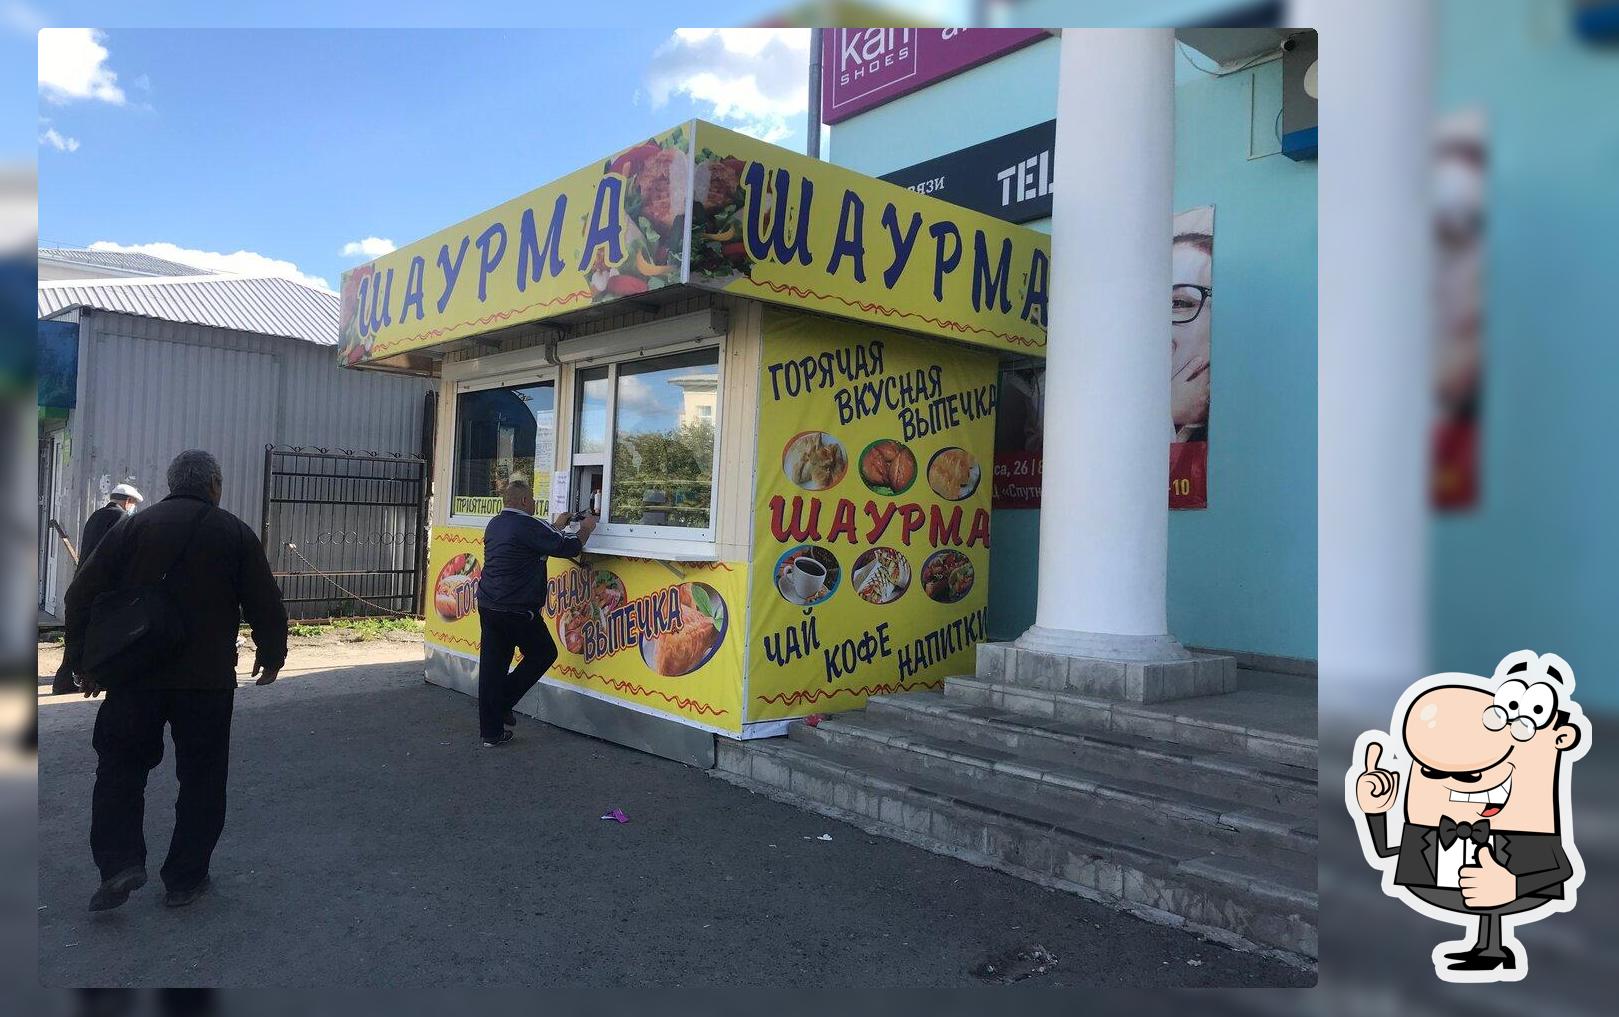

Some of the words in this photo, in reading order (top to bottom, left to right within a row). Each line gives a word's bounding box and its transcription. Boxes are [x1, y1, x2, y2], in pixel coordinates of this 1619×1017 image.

[841, 47, 909, 86] SHOES
[997, 150, 1054, 206] TEL
[358, 176, 624, 336] ШАУРМА
[744, 160, 1048, 328] ШАУРМА
[768, 341, 885, 401] ГОРЯЧАЯ
[834, 365, 943, 426] ВКУСНАЯ
[898, 384, 996, 442] ВЫПЕЧКА
[769, 495, 990, 548] ШАУРМА
[546, 565, 593, 618] СНАЯ
[580, 585, 684, 664] ВЫПЕЧКА
[763, 607, 820, 667] ЧАЙ
[824, 622, 892, 683] КОФЕ
[898, 606, 989, 682] НАПИТКИ
